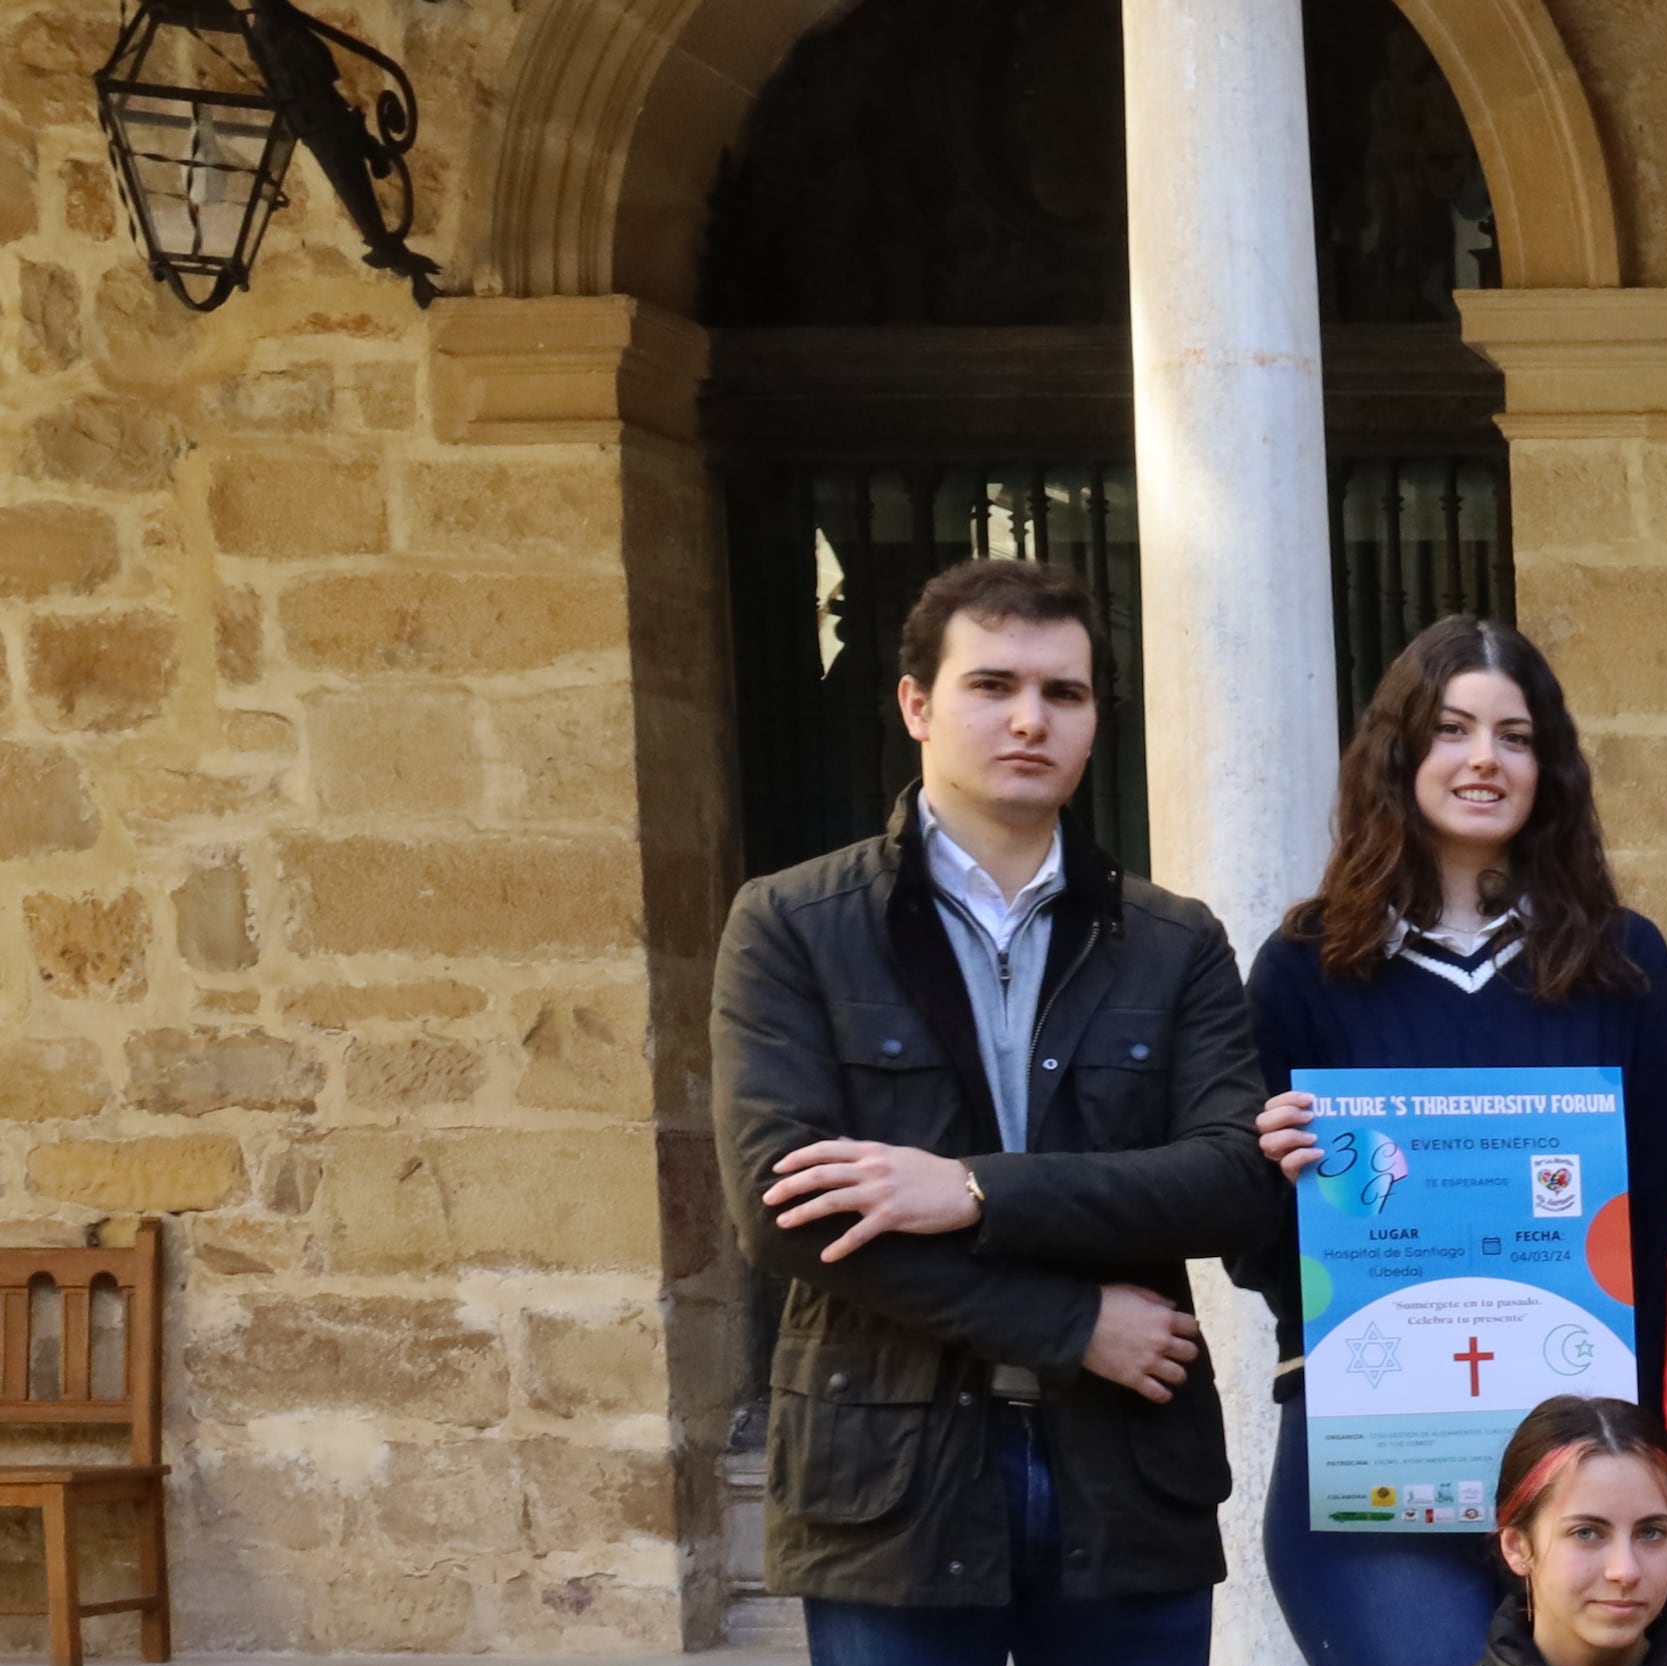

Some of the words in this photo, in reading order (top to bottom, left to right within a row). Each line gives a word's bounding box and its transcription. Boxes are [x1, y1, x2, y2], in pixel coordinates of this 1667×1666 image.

[1313, 1097, 1386, 1117] ULTURE
[1414, 1095, 1546, 1115] THREEVERSITY
[1551, 1094, 1615, 1113] FORUM
[1411, 1139, 1473, 1150] EVENTO
[1482, 1137, 1559, 1149] BENÉFICO
[1425, 1179, 1438, 1188] TE
[1442, 1178, 1508, 1187] ESPERAMOS
[1370, 1229, 1419, 1240] LUGAR
[1516, 1230, 1563, 1242] FECHA:
[1324, 1246, 1380, 1260] Hospital
[1385, 1247, 1402, 1257] de
[1406, 1246, 1465, 1259] Santiago
[1511, 1250, 1571, 1263] 04/03/24
[1482, 1299, 1493, 1307] tu
[1408, 1316, 1453, 1325] Celebra
[1457, 1315, 1469, 1323] tu
